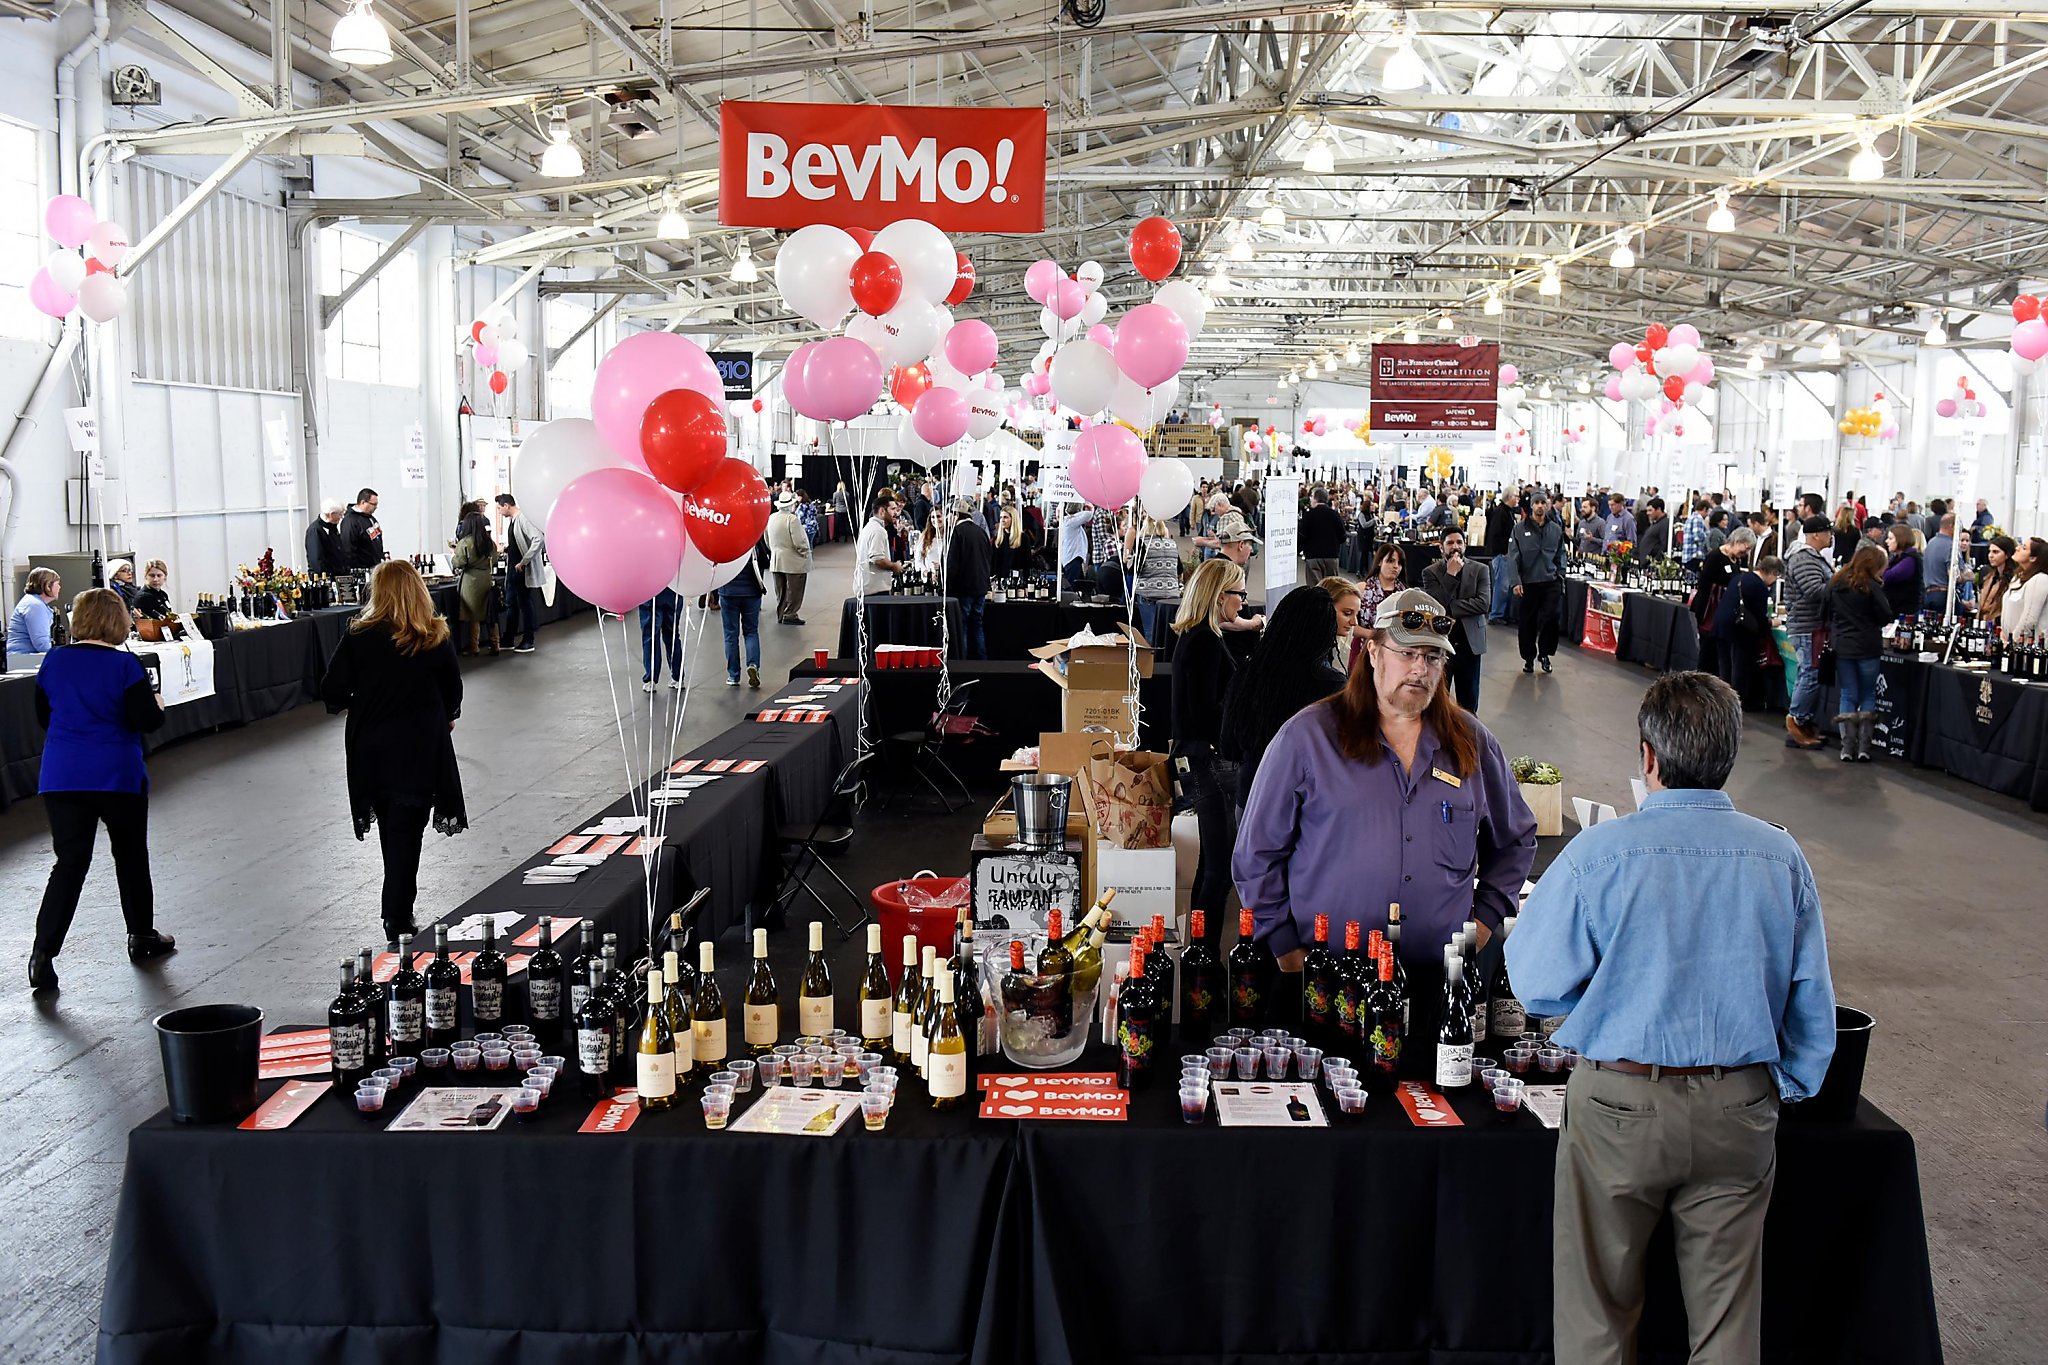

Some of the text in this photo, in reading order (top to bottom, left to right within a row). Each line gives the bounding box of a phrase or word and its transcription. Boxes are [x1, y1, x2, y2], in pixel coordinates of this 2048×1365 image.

[746, 132, 1015, 204] BevMo!
[971, 406, 998, 417] BevMo!
[1384, 413, 1417, 423] BevMo!
[683, 500, 732, 526] BevMo!
[1414, 603, 1440, 616] AUSTIN
[991, 866, 1057, 890] Unruly
[988, 889, 1063, 904] RAMPANT
[1034, 1077, 1112, 1085] BevMo!
[992, 1091, 1124, 1100] I BevMo!
[986, 1106, 1121, 1116] I BevMo!
